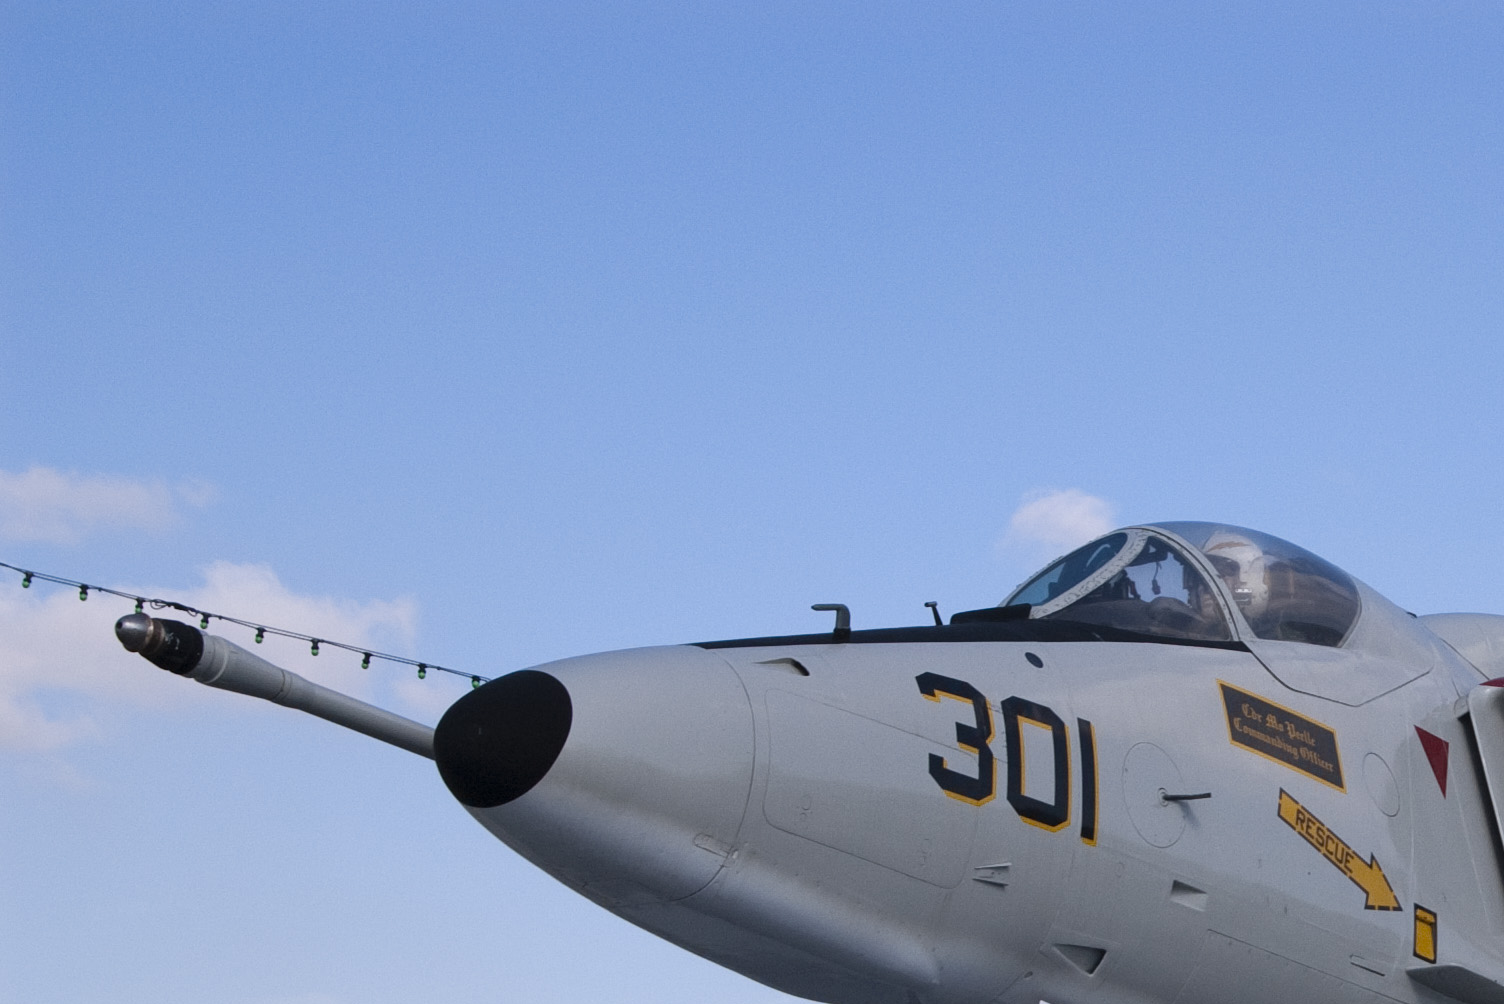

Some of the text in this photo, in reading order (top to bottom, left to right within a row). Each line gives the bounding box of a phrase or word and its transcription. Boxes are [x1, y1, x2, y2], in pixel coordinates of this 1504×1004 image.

[916, 672, 1098, 846] 301
[1233, 717, 1334, 772] Commanding Officer
[1295, 808, 1355, 873] RESCUE
